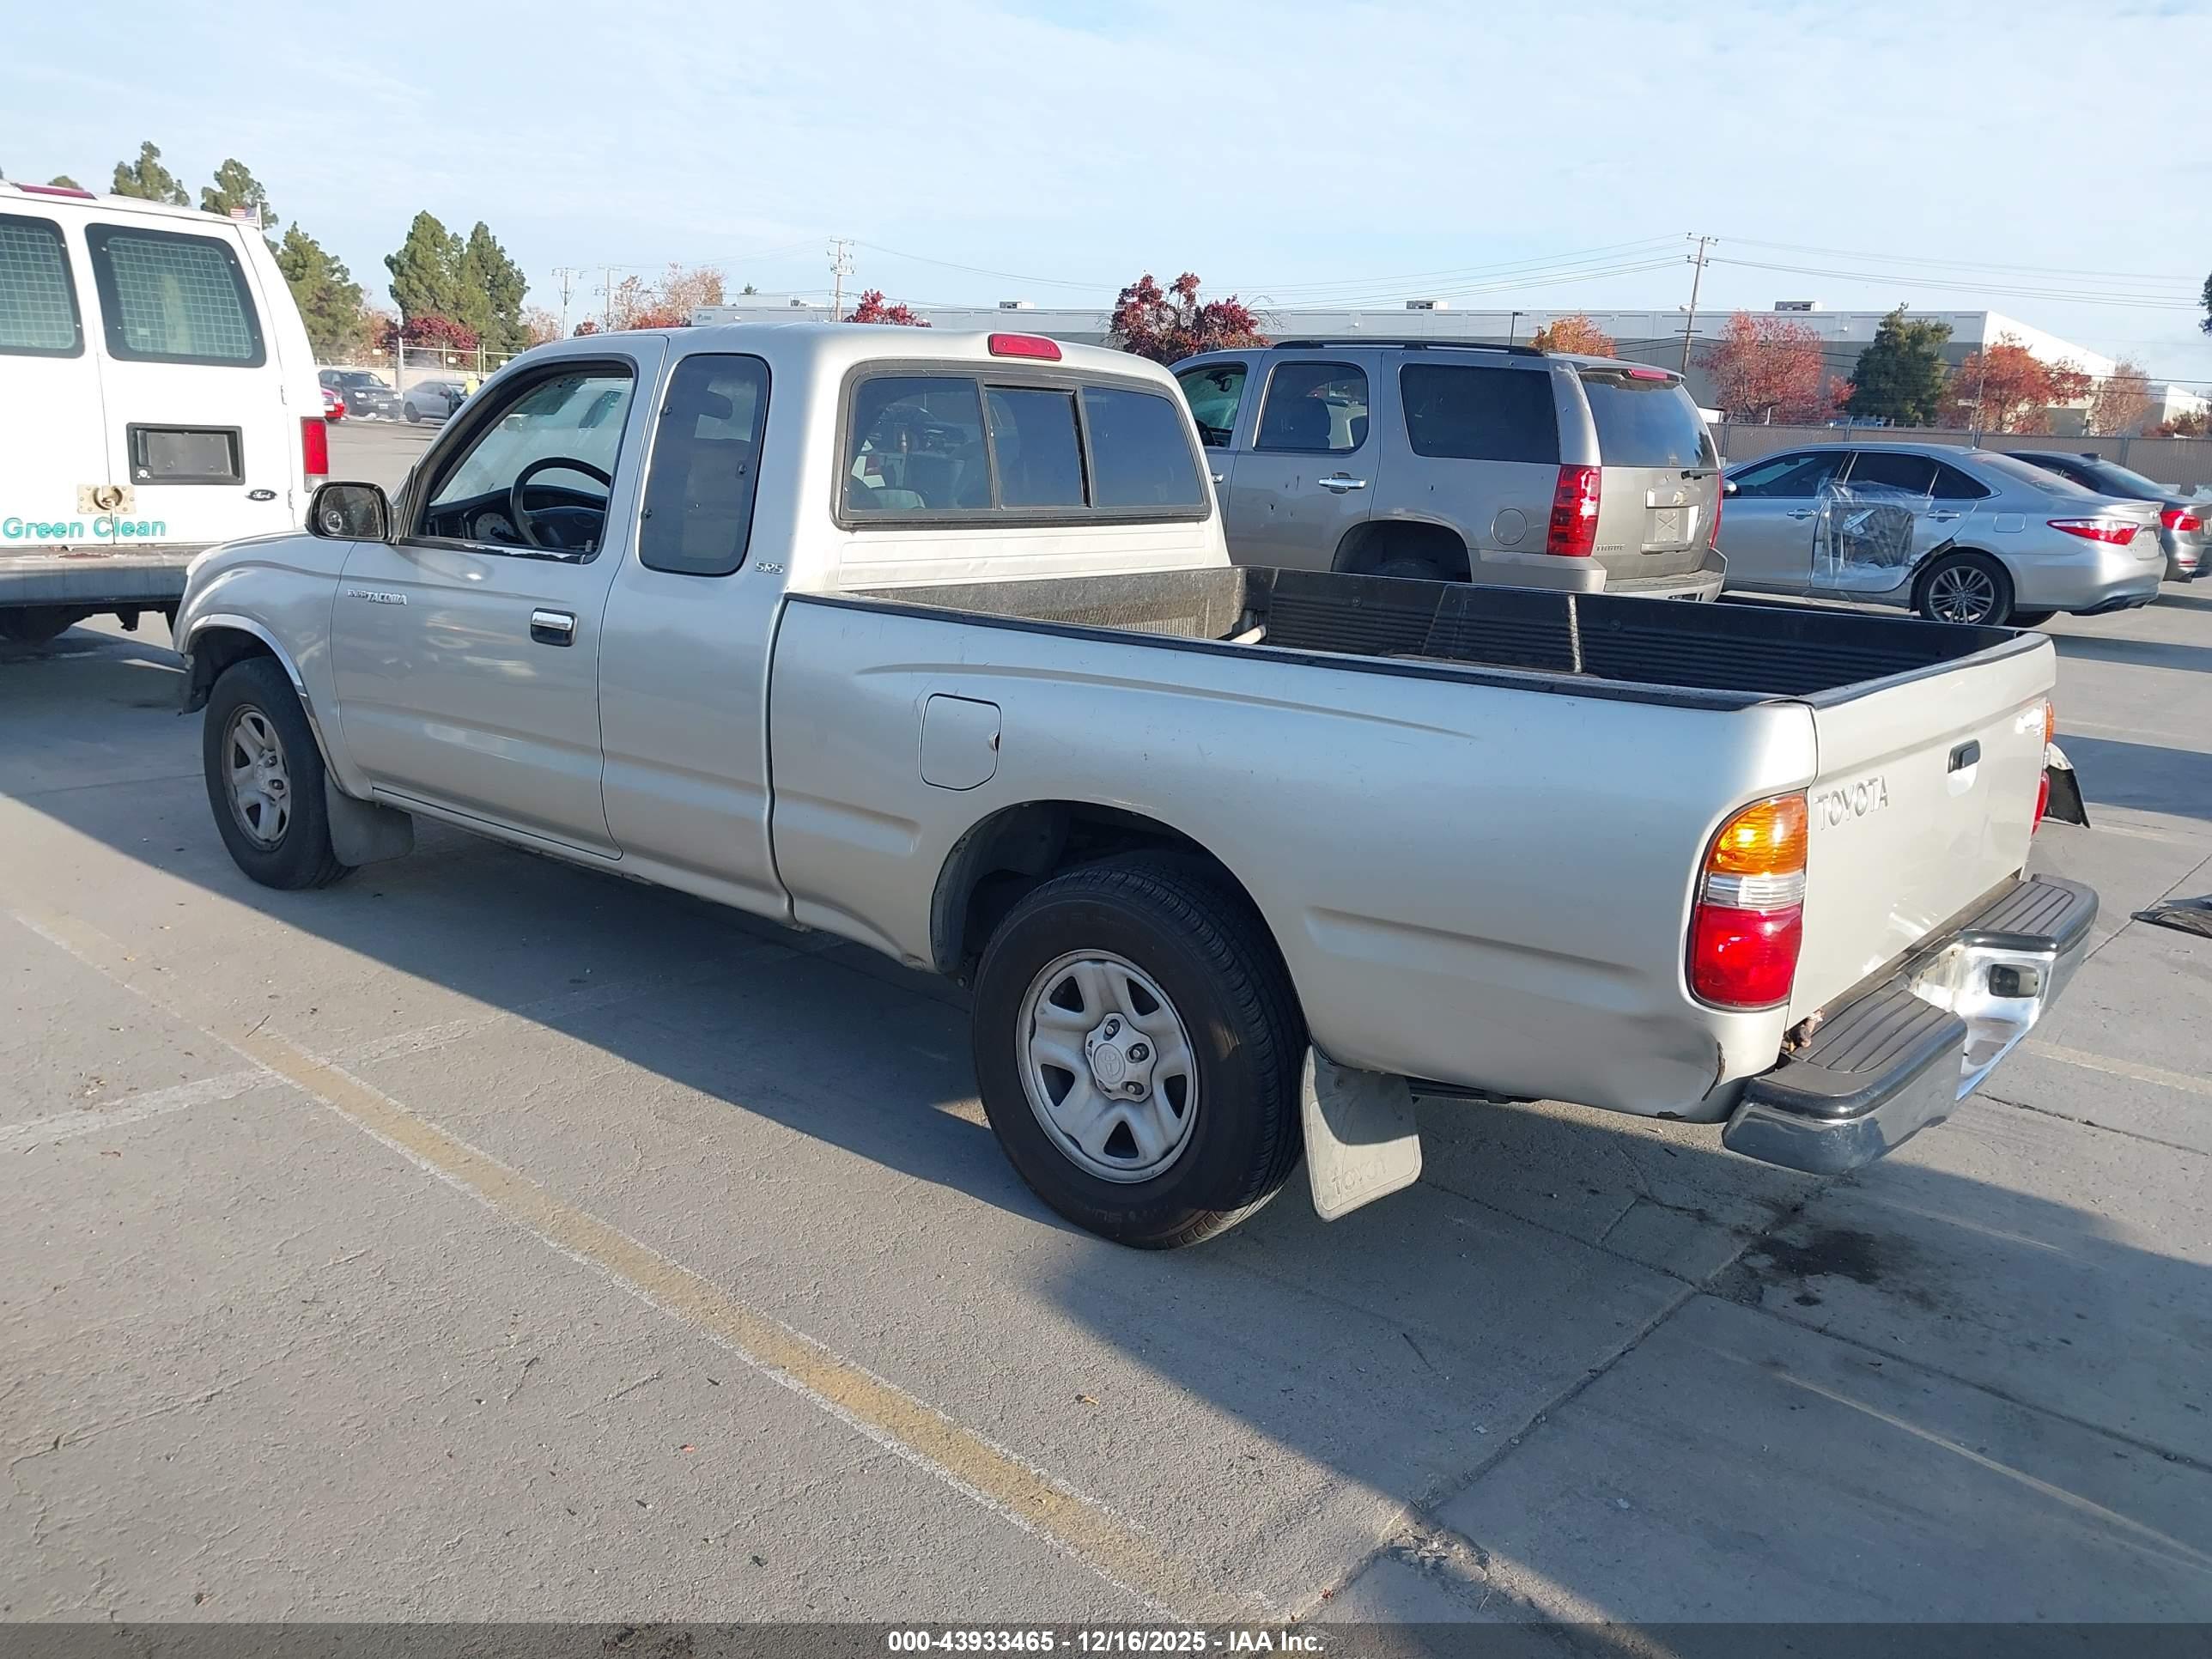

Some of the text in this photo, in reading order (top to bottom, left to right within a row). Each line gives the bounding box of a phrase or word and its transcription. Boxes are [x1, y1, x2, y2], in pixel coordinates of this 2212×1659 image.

[2, 516, 166, 539] Green Clean
[1813, 775, 1890, 831] TOYOTA
